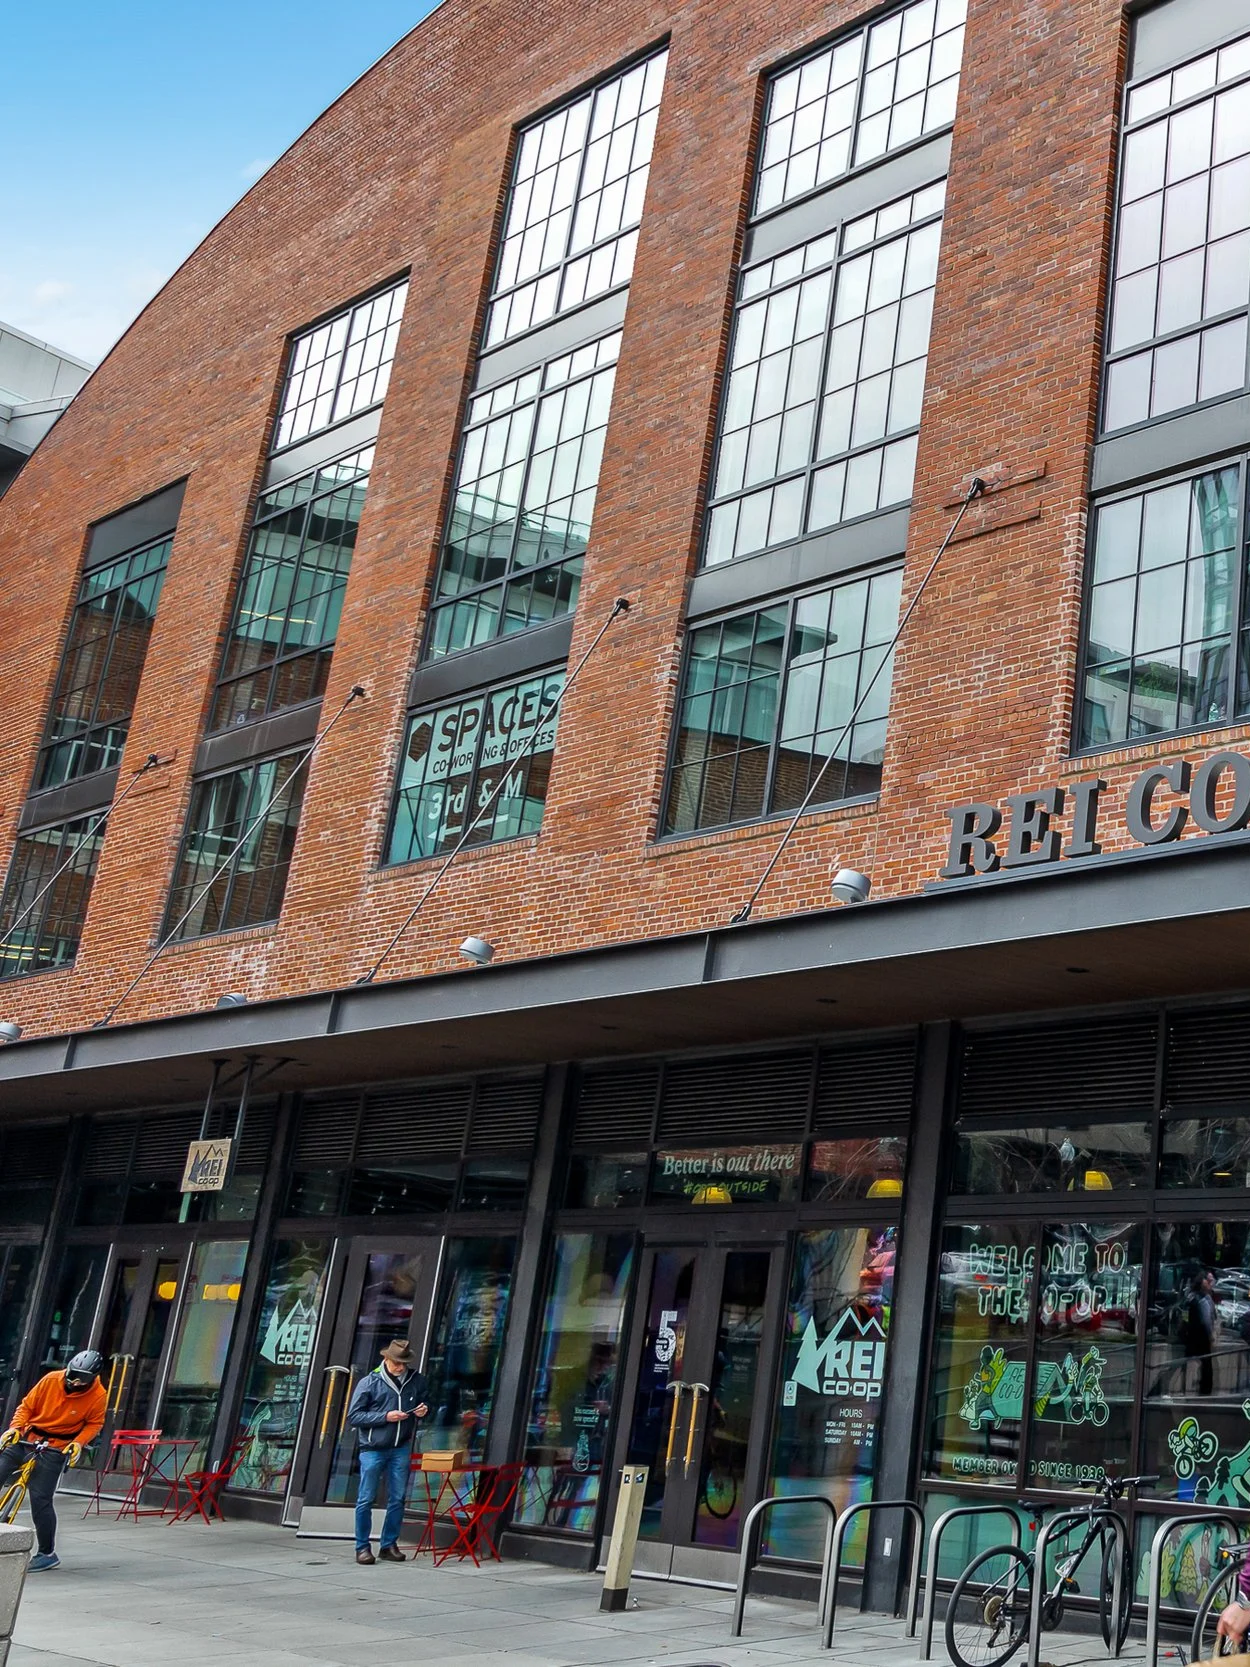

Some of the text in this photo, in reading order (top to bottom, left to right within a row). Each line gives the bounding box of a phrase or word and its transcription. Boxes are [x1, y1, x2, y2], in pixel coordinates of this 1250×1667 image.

[433, 745, 497, 774] CO-WORNG
[510, 730, 555, 754] OFFCES
[428, 770, 523, 820] 3rd & M
[939, 778, 1108, 878] REI
[662, 1150, 795, 1175] Better is out there
[970, 1242, 1126, 1277] WELCME TO
[978, 1285, 1108, 1316] THE O-OP
[279, 1324, 317, 1353] REI
[824, 1341, 886, 1379] REI
[1009, 1367, 1025, 1383] RE
[998, 1382, 1024, 1399] CO-O
[839, 1408, 863, 1418] HOURS
[952, 1457, 1105, 1480] MEMBER OWD SINCE 1938
